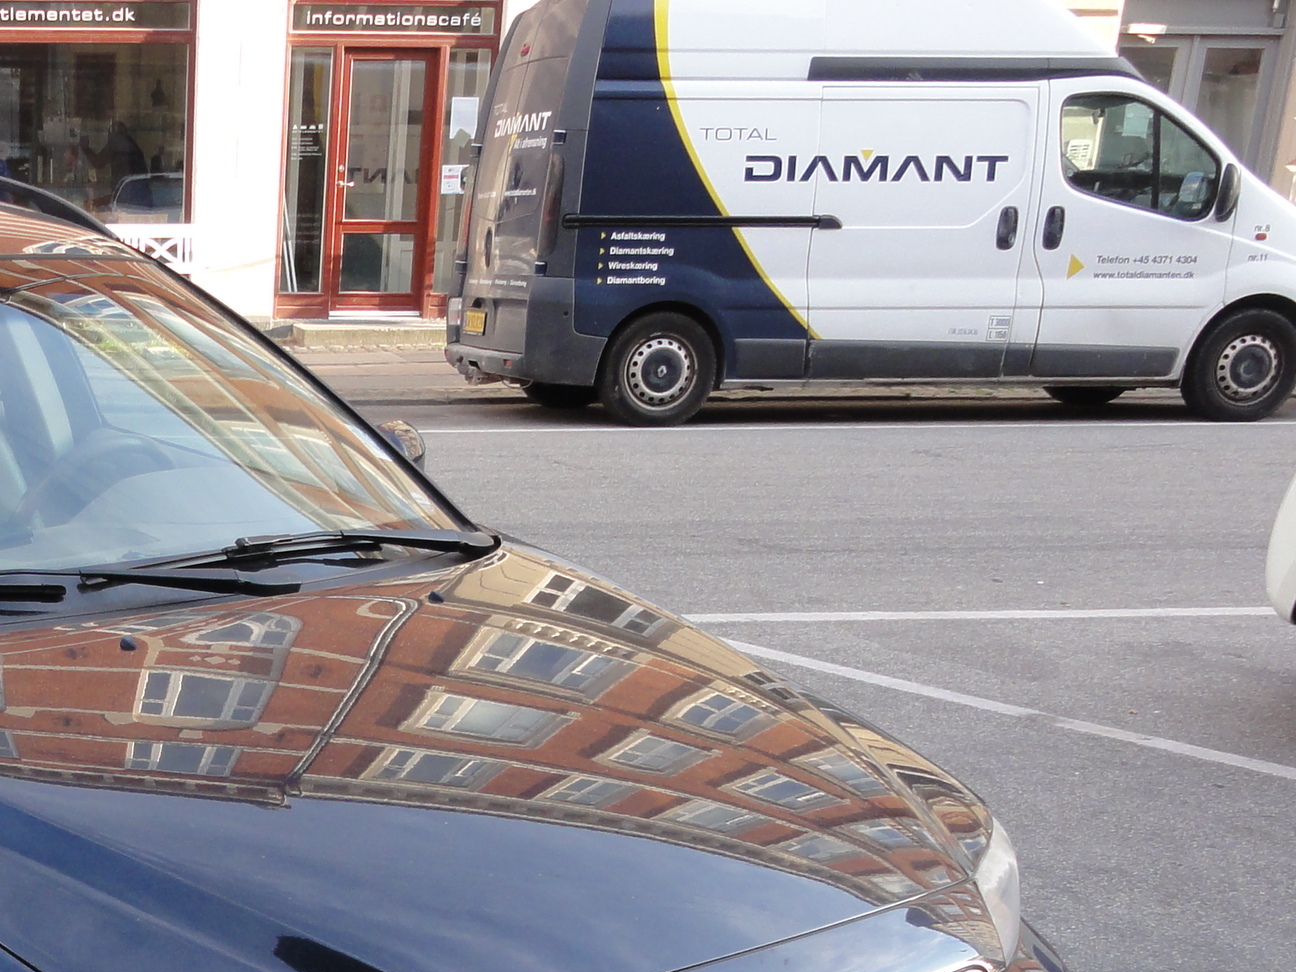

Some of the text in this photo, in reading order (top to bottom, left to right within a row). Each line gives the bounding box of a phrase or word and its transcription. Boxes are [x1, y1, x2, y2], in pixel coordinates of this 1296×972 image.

[306, 11, 482, 27] informationscafé
[494, 111, 552, 138] DIAMANT
[699, 127, 777, 141] TOTAL
[744, 155, 1009, 182] DIAMANT
[610, 231, 666, 242] Asfaltskæring
[609, 246, 675, 257] Diamantskæring
[1096, 255, 1198, 264] Telefon +45 4371 4304
[608, 261, 659, 271] Wireskæring
[1093, 271, 1195, 279] www.totaldiamanten.dk
[607, 276, 666, 286] Diamantboring
